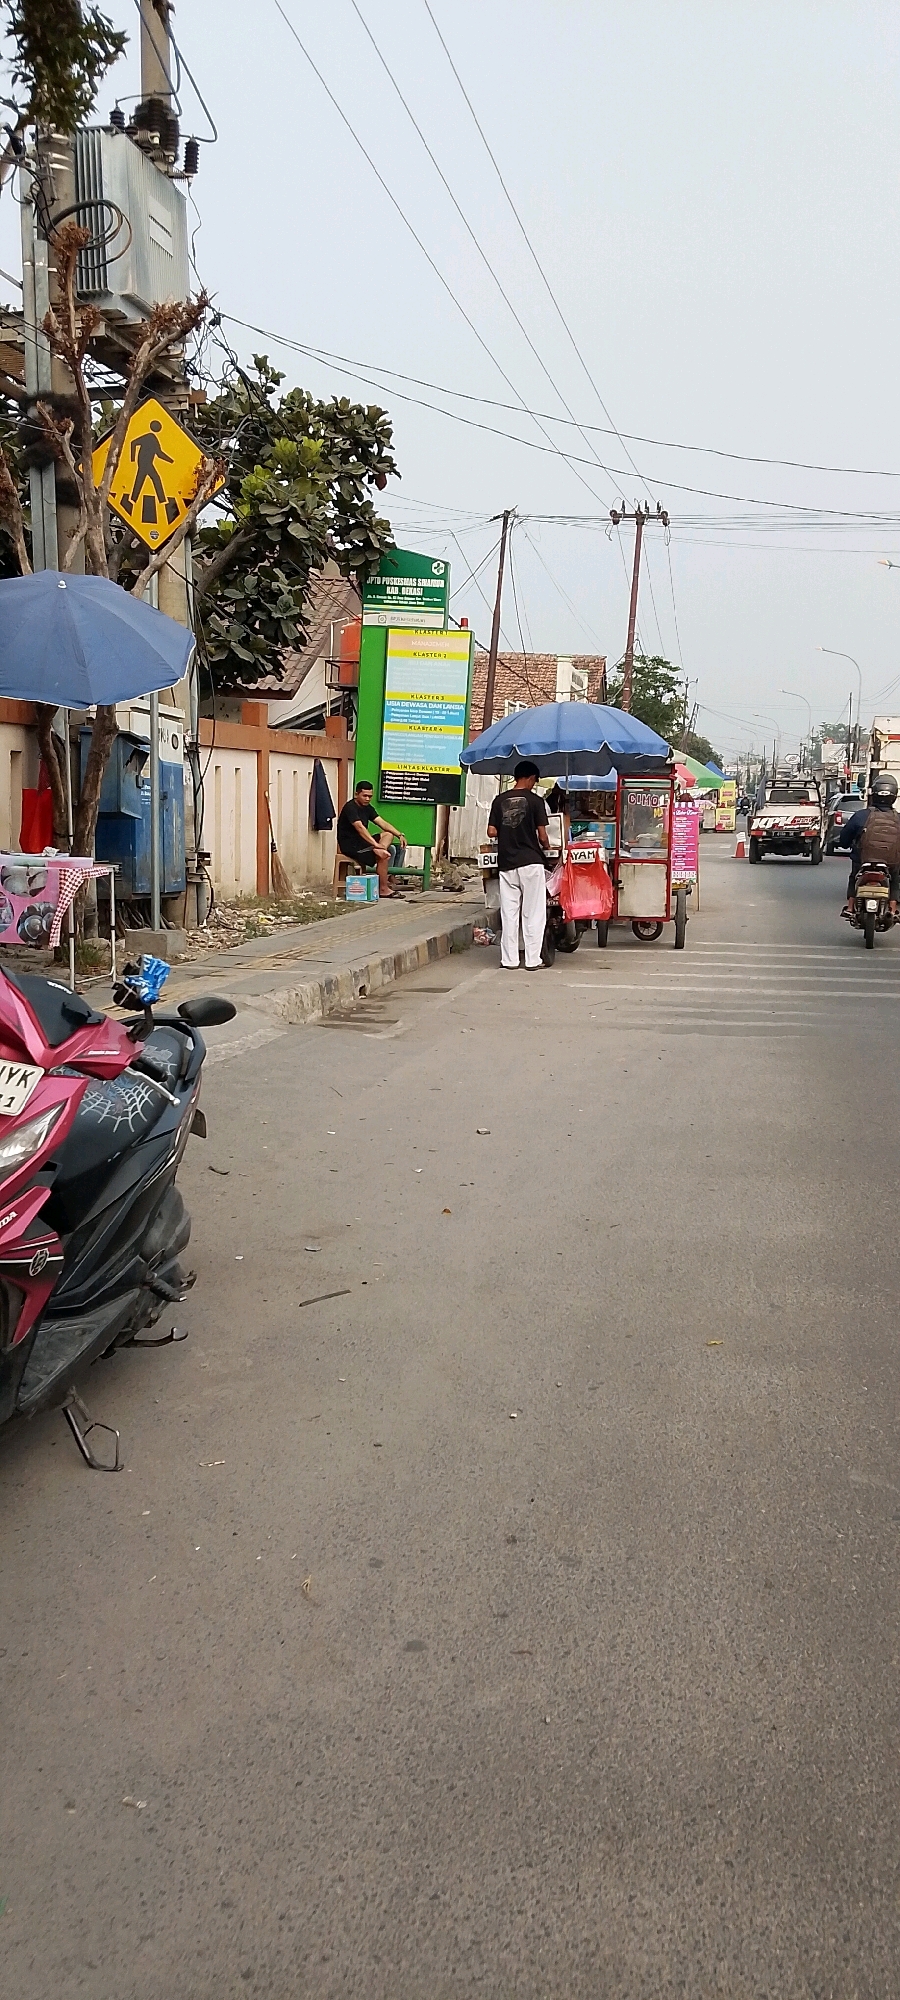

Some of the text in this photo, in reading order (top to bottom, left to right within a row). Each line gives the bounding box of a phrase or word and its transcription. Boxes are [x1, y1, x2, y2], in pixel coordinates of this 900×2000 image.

[382, 577, 417, 587] PUSKESMAS
[402, 587, 424, 596] BEKASI
[411, 640, 450, 648] MANAJEMEN
[401, 701, 428, 709] DEWASA
[483, 855, 497, 866] BU
